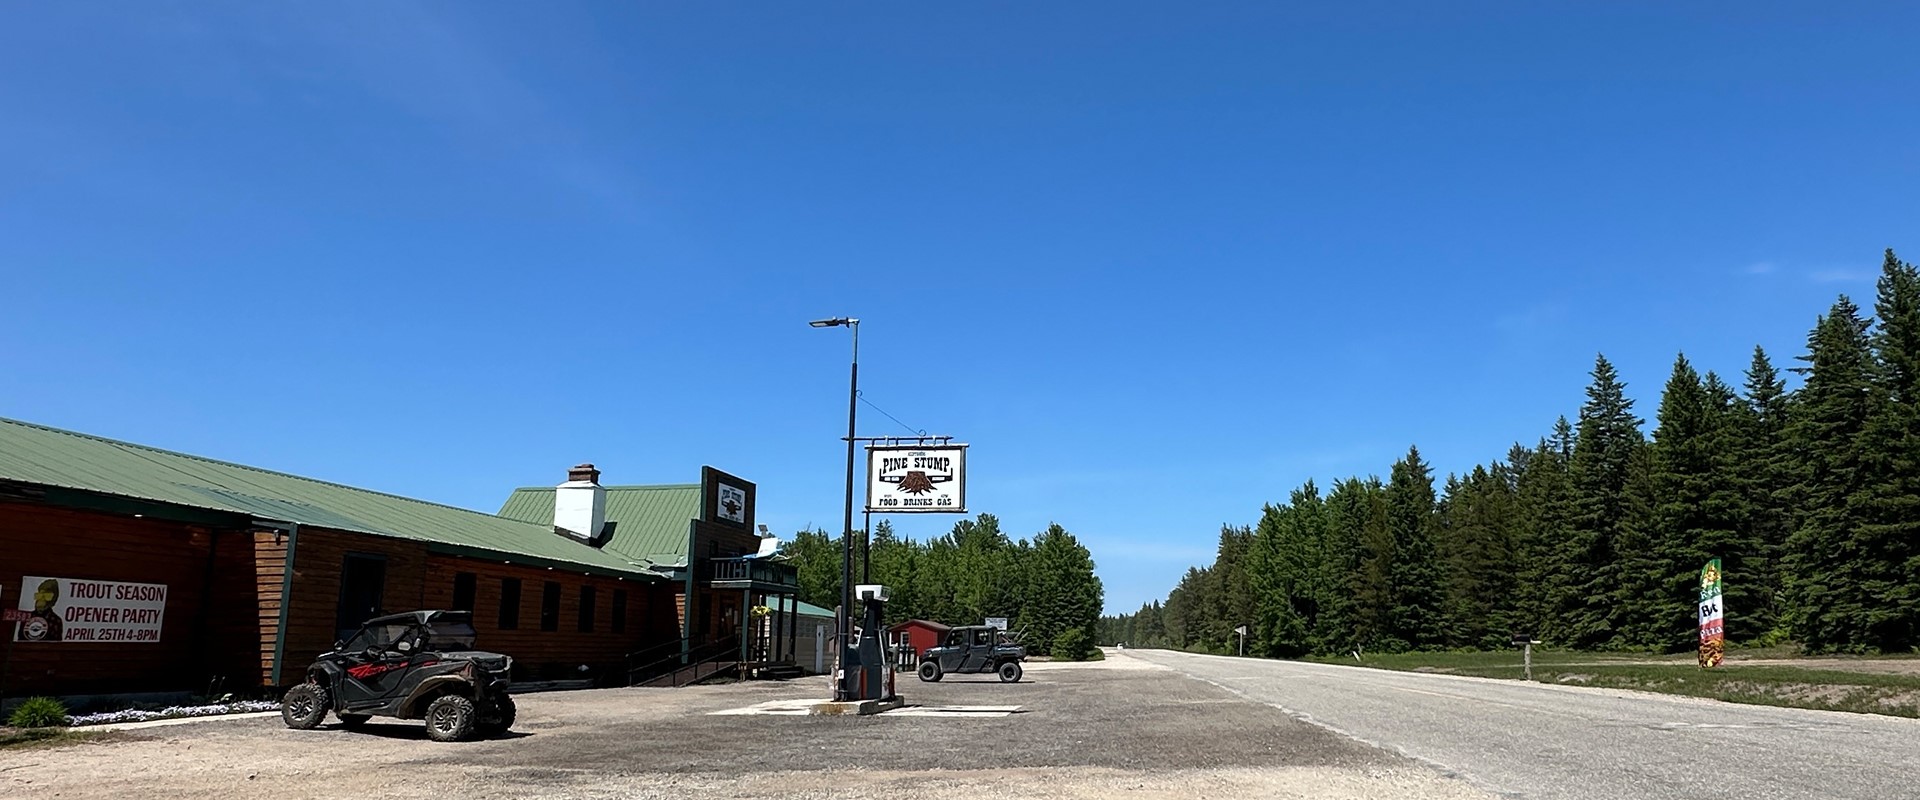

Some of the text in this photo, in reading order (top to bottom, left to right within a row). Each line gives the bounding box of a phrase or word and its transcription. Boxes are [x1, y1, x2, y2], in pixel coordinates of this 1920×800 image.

[883, 456, 950, 475] PINE STUMP
[879, 498, 952, 506] FOOD DRINKS GAS
[69, 582, 165, 602] TROUT SEASON
[65, 606, 161, 624] OPENER PARTY
[64, 628, 96, 641] APRIL
[98, 628, 126, 641] 25TH
[126, 629, 159, 641] 4-8PM
